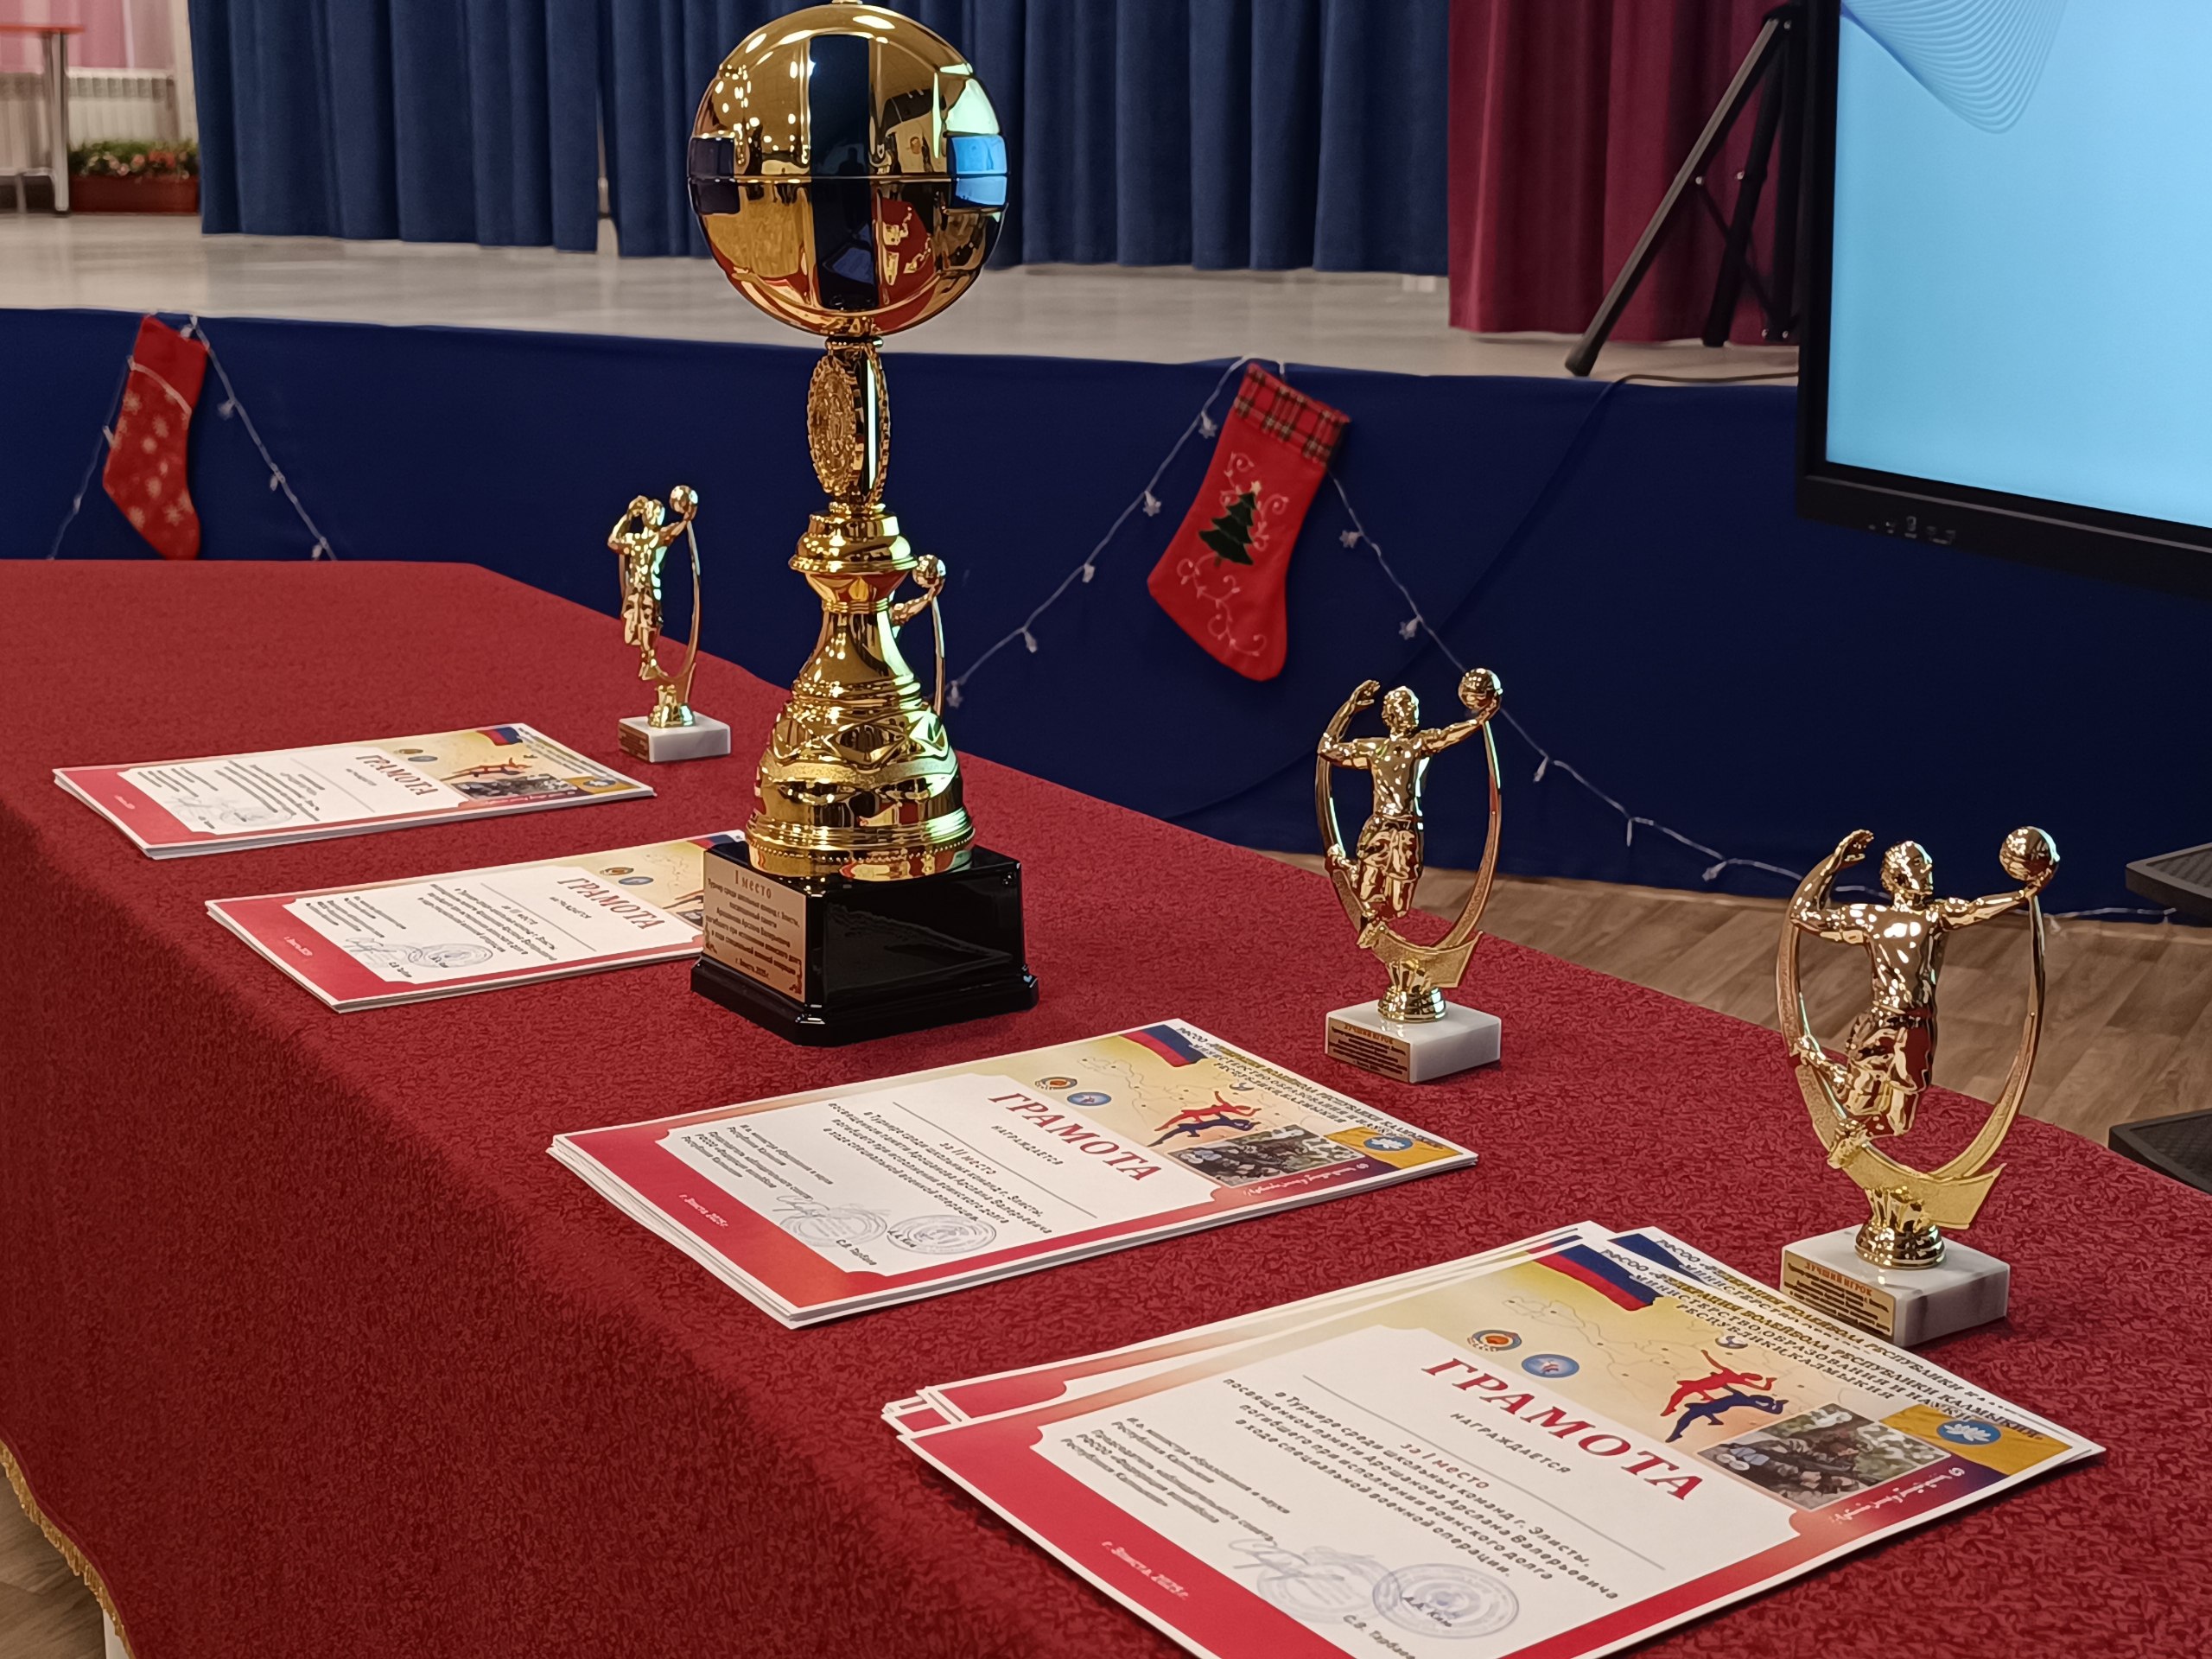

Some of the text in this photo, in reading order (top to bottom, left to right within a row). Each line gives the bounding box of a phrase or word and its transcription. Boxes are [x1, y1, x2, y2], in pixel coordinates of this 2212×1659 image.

[557, 878, 664, 929] ГРАМОТА
[742, 877, 771, 899] место
[961, 1155, 996, 1174] место
[988, 1093, 1161, 1180] ГРАМОТА
[1804, 1260, 1872, 1296] ЛУЧШИЙ ИГРОК
[1630, 1274, 1764, 1332] МИНИСТЕРСТВО
[1758, 1330, 1891, 1386] ОБРАЗОВАНИЯ
[1828, 1348, 1941, 1395] РЕСПУБЛИКИ
[1287, 1396, 1341, 1427] Турнире
[1341, 1427, 1383, 1449] среди
[1382, 1450, 1458, 1489] школьных
[1457, 1489, 1514, 1520] команд
[1421, 1358, 1702, 1500] ГРАМОТА
[1450, 1414, 1571, 1472] НАГРАЖДАЕТСЯ
[1224, 1379, 1313, 1428] посвященном
[1313, 1429, 1364, 1455] памяти
[1445, 1499, 1510, 1535] Арслана
[1510, 1535, 1618, 1599] Валерьевича
[1239, 1405, 1553, 1580] погибшего при исполнении воинского долга
[1245, 1425, 1278, 1442] ходе
[1278, 1443, 1371, 1492] специальной
[1369, 1493, 1435, 1527] военной
[1400, 1444, 1421, 1453] за
[1432, 1459, 1489, 1488] место
